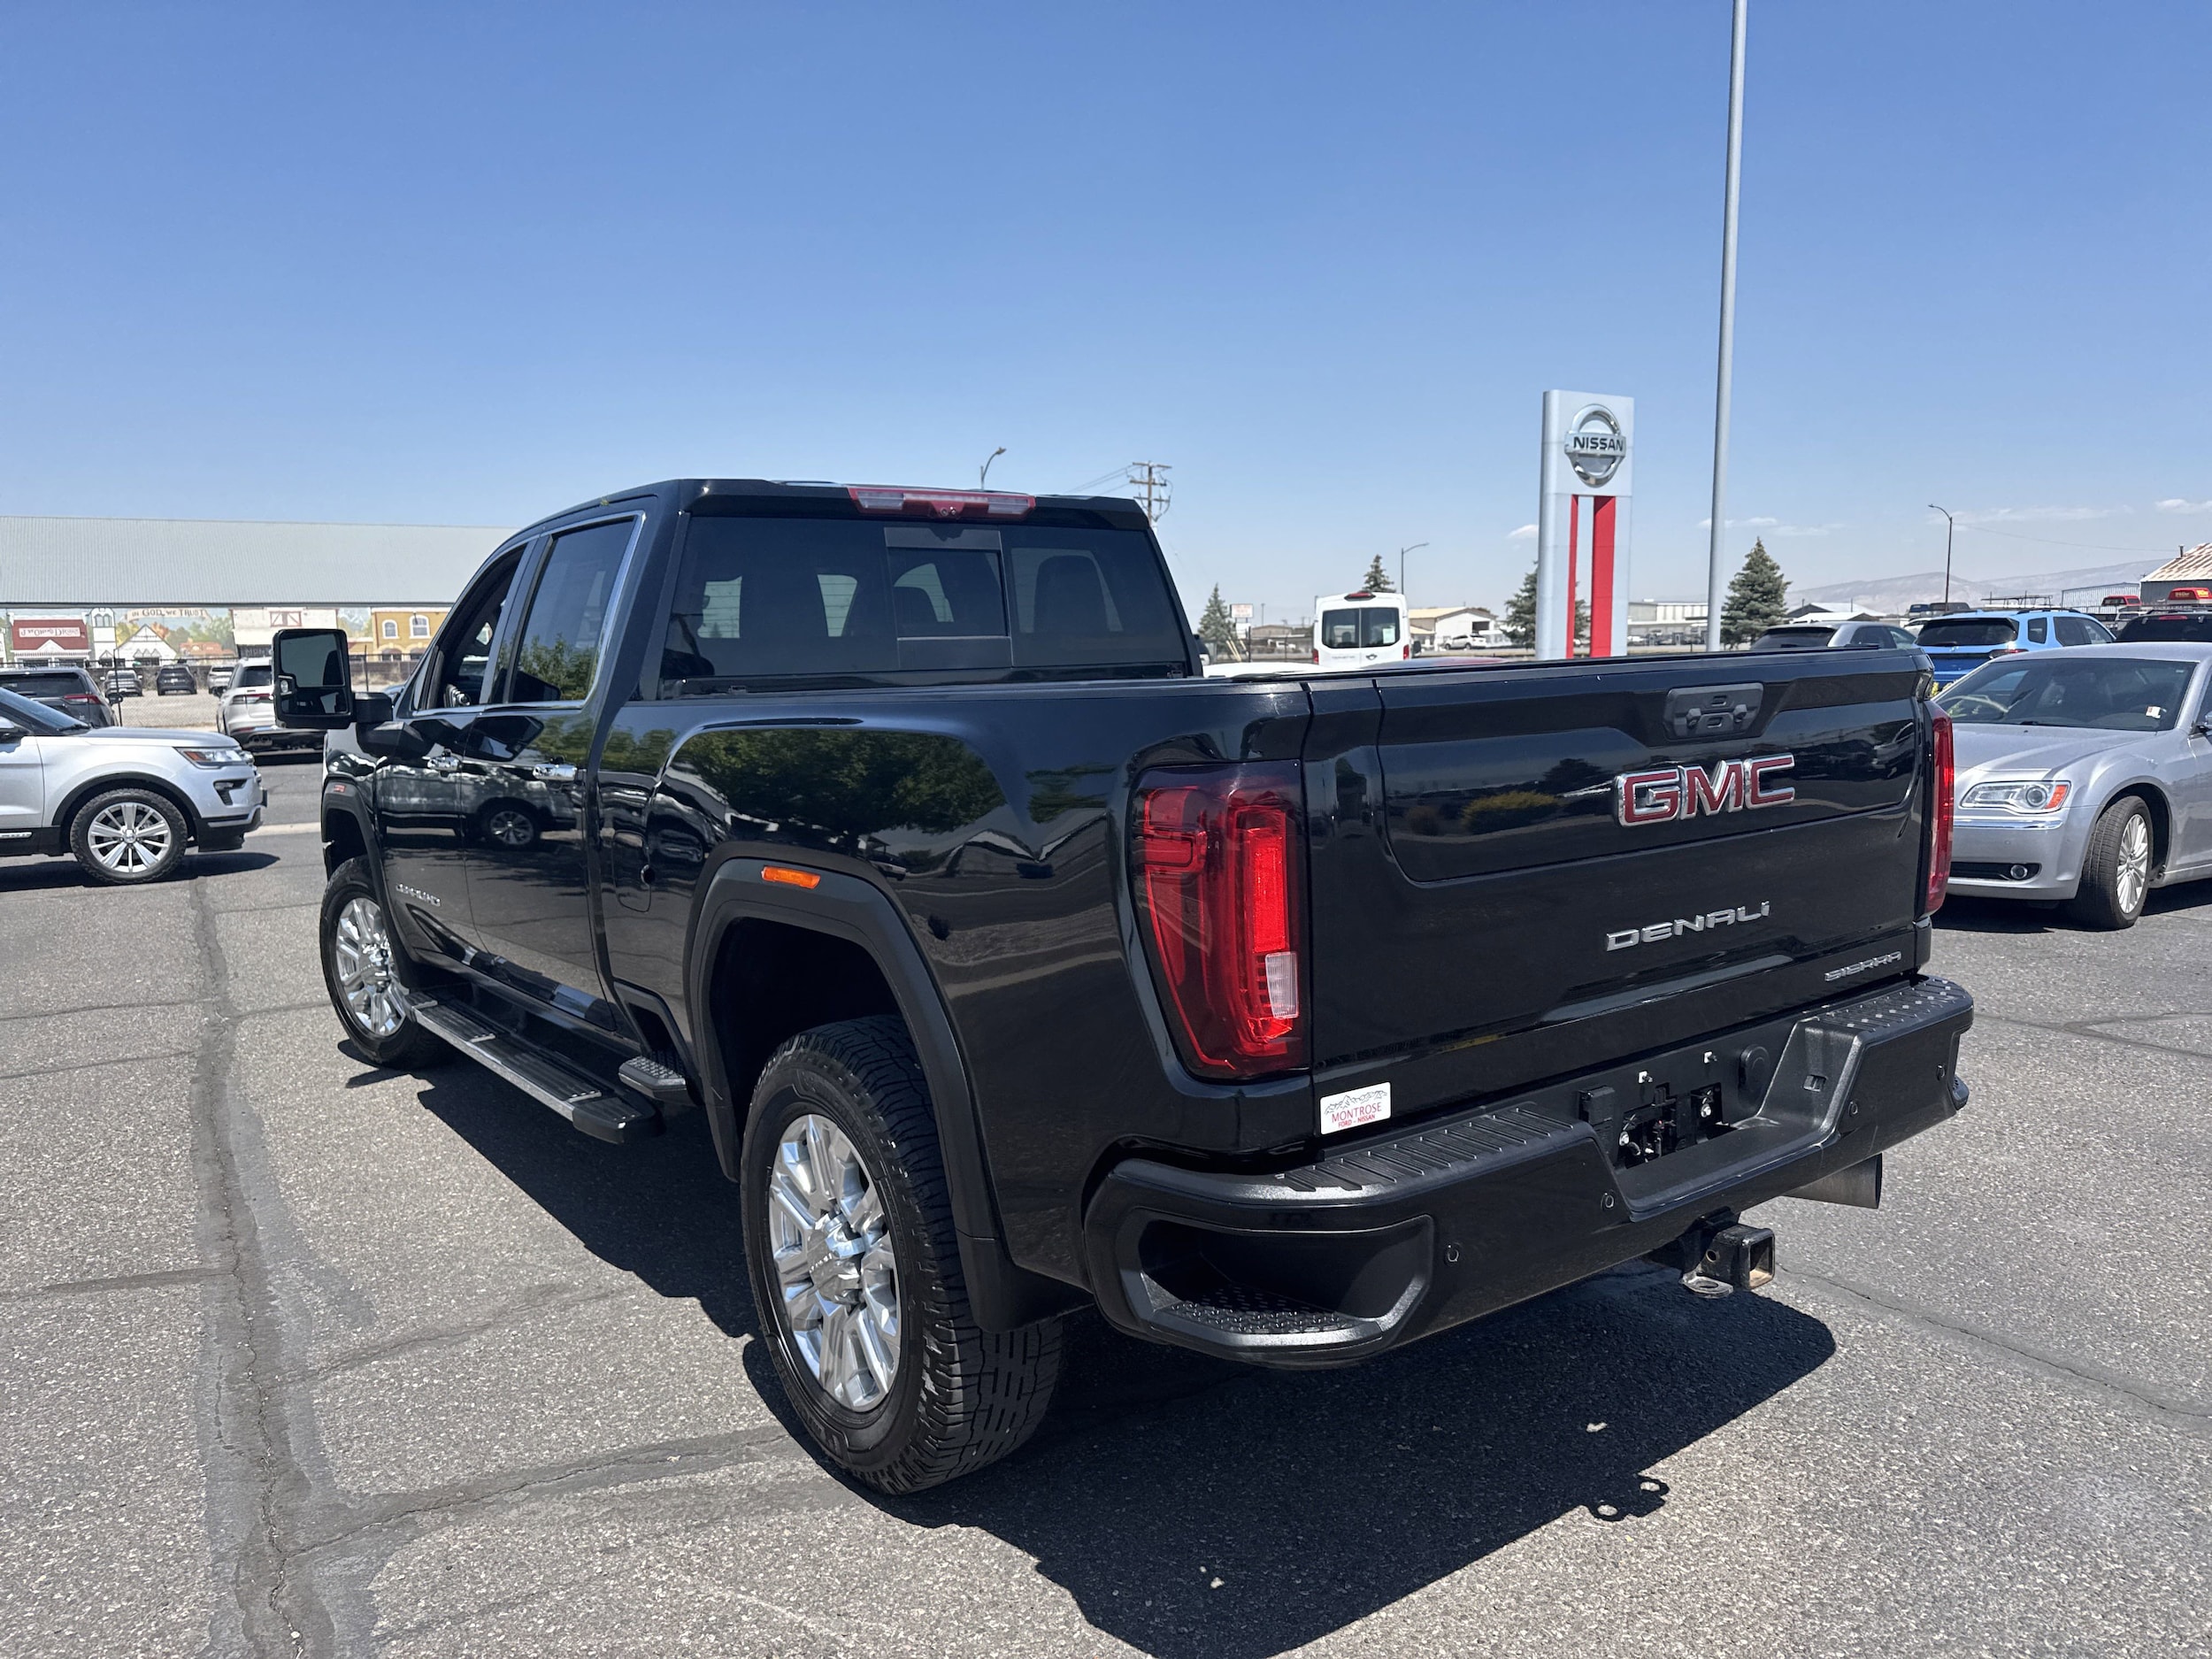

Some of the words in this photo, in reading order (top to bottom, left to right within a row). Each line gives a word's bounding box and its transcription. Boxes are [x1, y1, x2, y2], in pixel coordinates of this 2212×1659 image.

[1573, 436, 1624, 451] NISSAN
[1616, 753, 1795, 826] GMC
[1606, 901, 1770, 951] DENALI
[1824, 951, 1902, 981] SIERRA
[1332, 1102, 1382, 1124] MONTROSE
[1338, 1119, 1352, 1128] FORD
[1357, 1114, 1376, 1124] NISSAN
